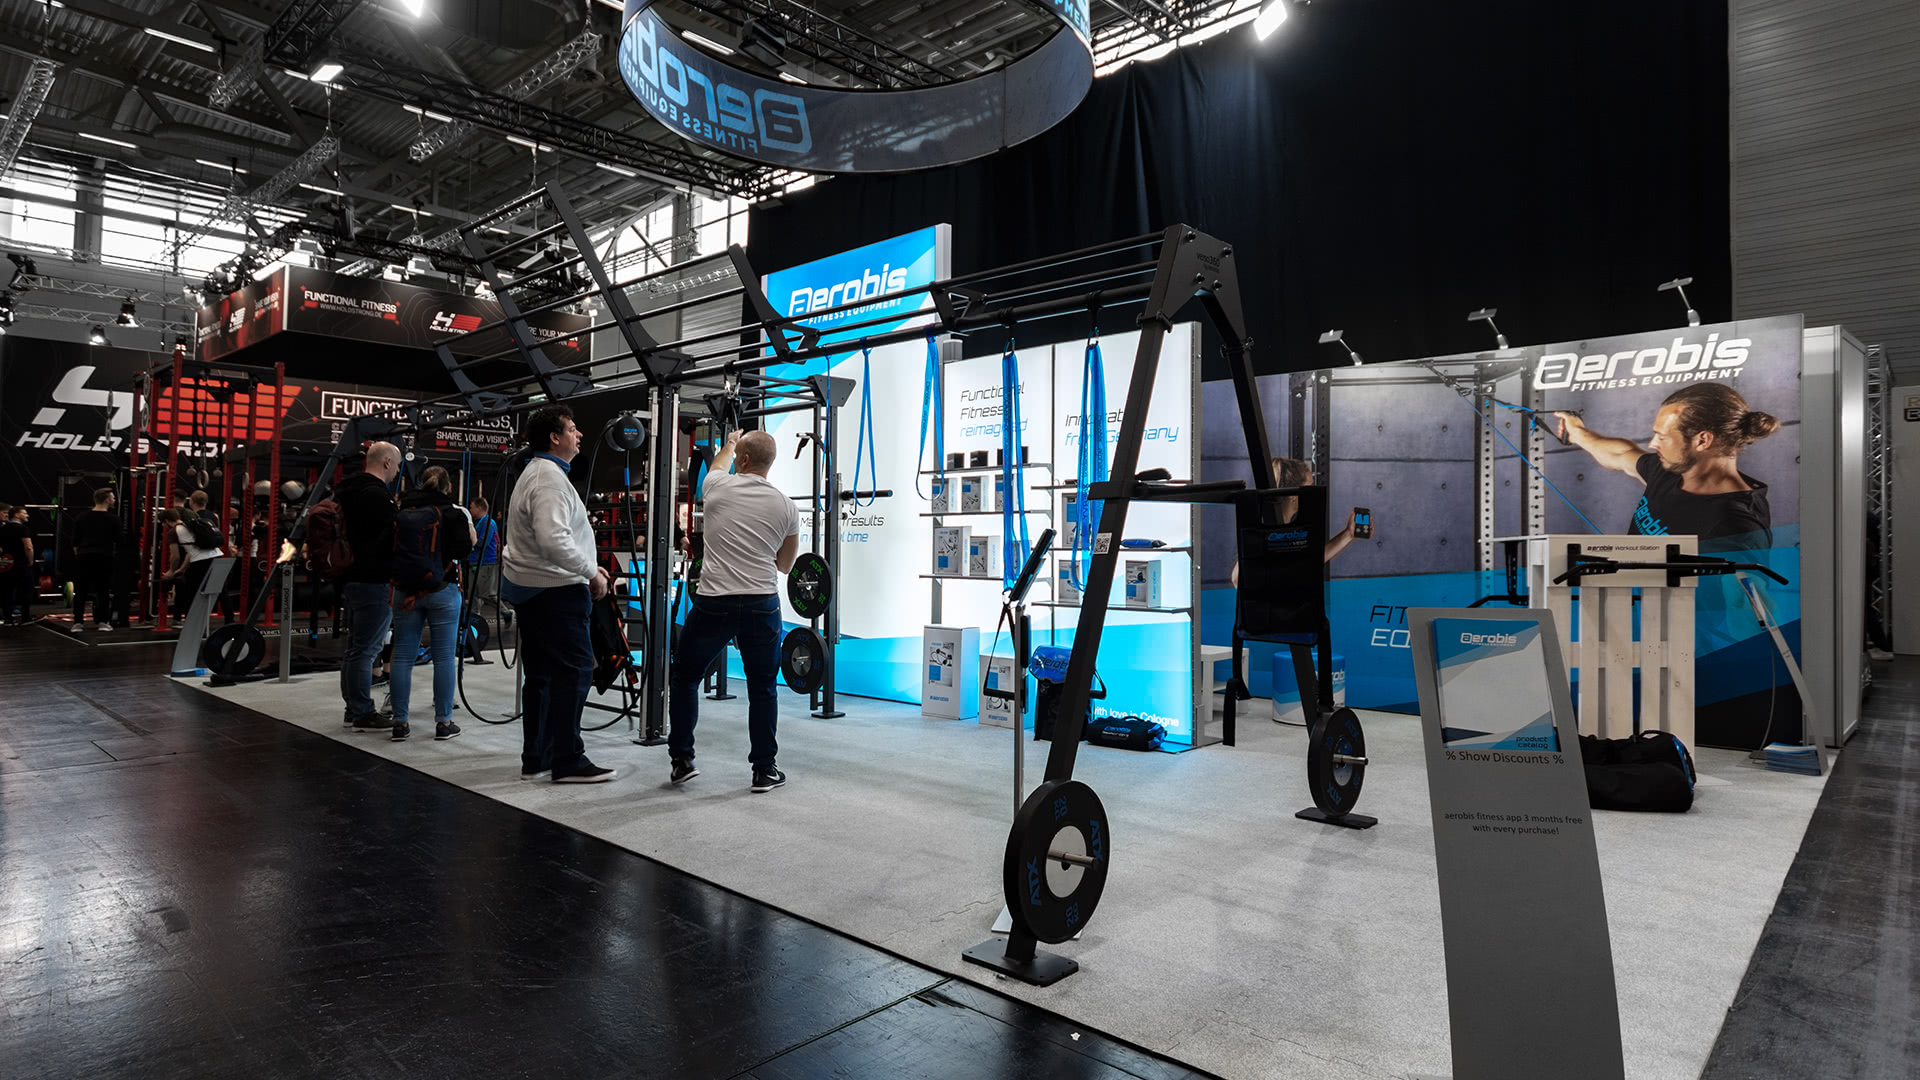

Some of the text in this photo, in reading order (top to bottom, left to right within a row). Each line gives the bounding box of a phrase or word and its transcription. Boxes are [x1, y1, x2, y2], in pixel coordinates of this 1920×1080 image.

[304, 290, 397, 313] FUNCTIONAL FITNESS
[788, 263, 908, 323] aerobis
[808, 299, 902, 325] FITNESS EQUIPMENT
[429, 325, 448, 333] HOLD
[1533, 332, 1752, 390] aerobis
[1570, 367, 1744, 392] FITNESS EQUIPMENT
[960, 381, 1025, 403] Functiol
[960, 405, 1004, 420] Fitness
[436, 431, 463, 442] SHARE
[960, 418, 1028, 437] reimagd
[1106, 426, 1179, 443] Geany
[16, 431, 122, 452] HOLD
[1460, 632, 1517, 644] aerobis
[1094, 706, 1107, 716] ith
[1110, 708, 1128, 719] love
[1140, 712, 1179, 727] Cologne
[1445, 751, 1564, 765] % Show Discounts %
[1444, 812, 1583, 824] aerobis fitness app 3 months free
[1472, 824, 1560, 835] with every purchase!
